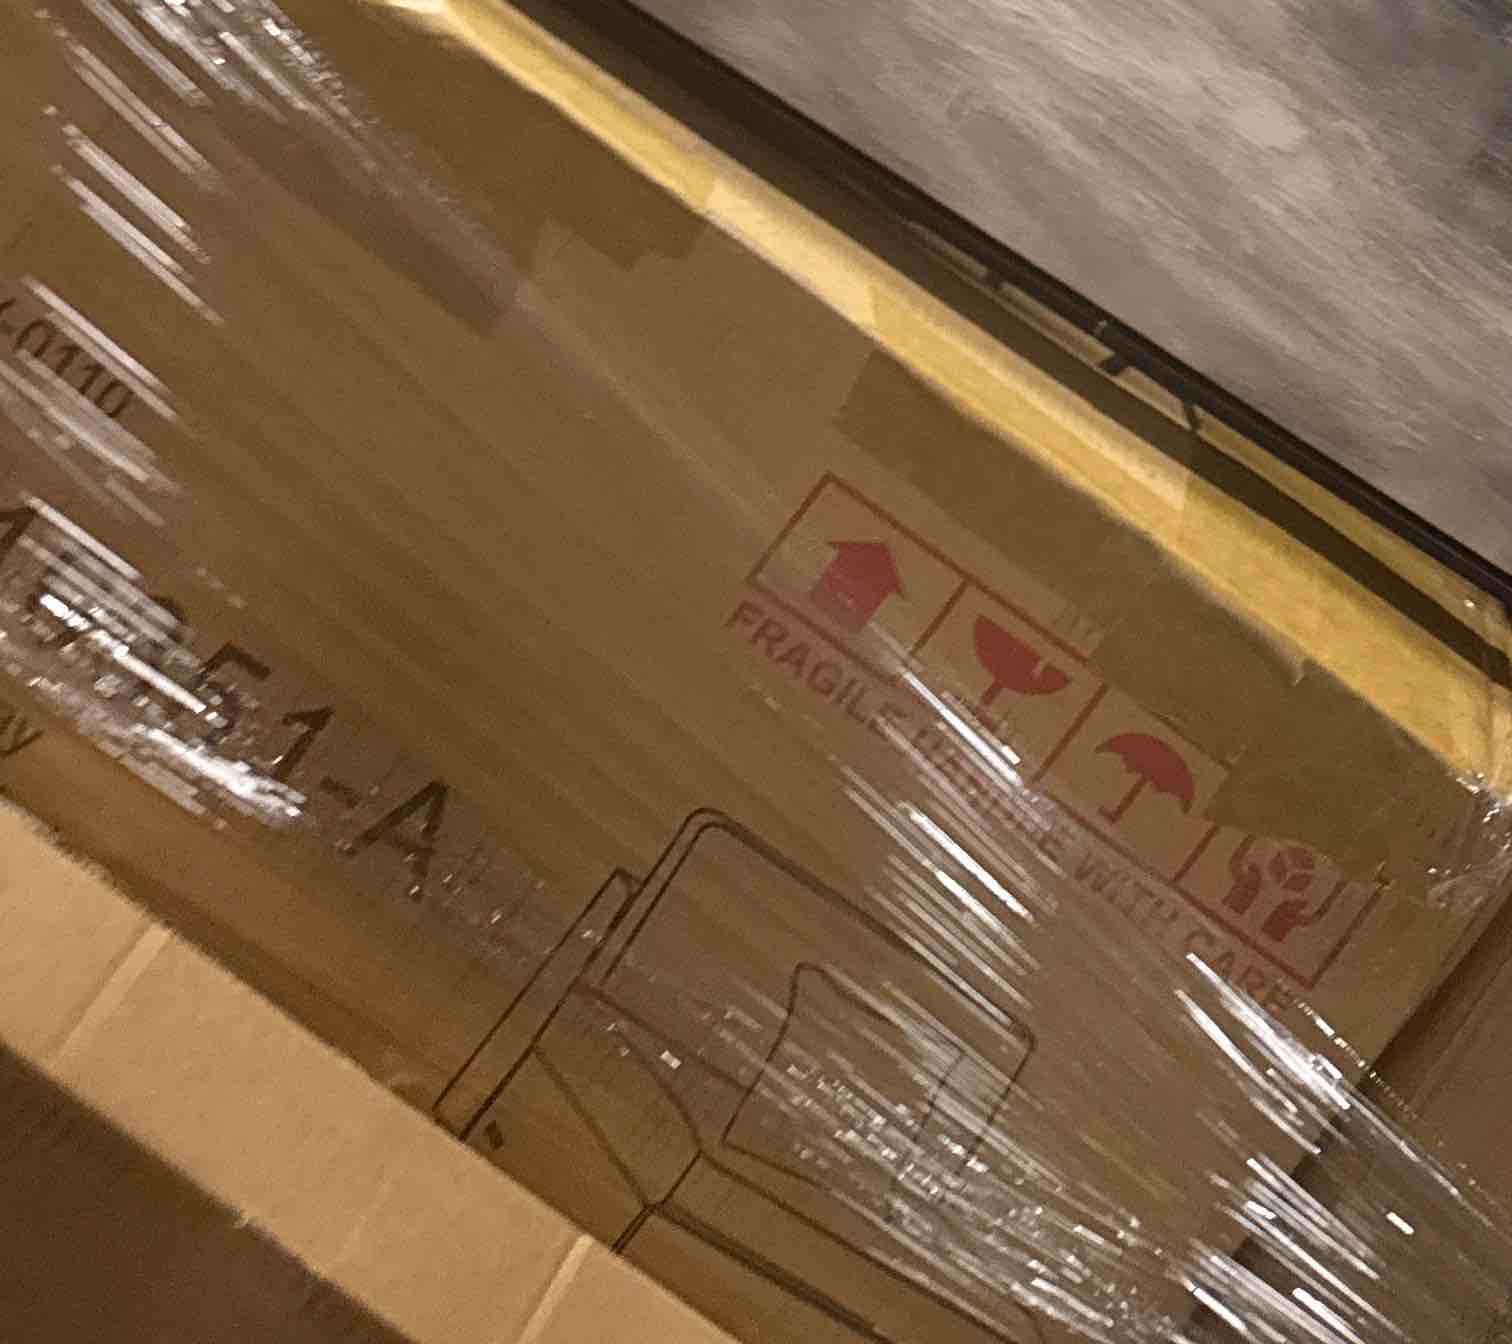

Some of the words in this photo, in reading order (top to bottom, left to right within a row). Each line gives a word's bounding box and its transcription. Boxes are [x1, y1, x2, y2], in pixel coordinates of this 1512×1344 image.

[725, 599, 908, 742] FRAGILE
[1072, 852, 1180, 928] WITH
[1183, 929, 1292, 1014] CARE
